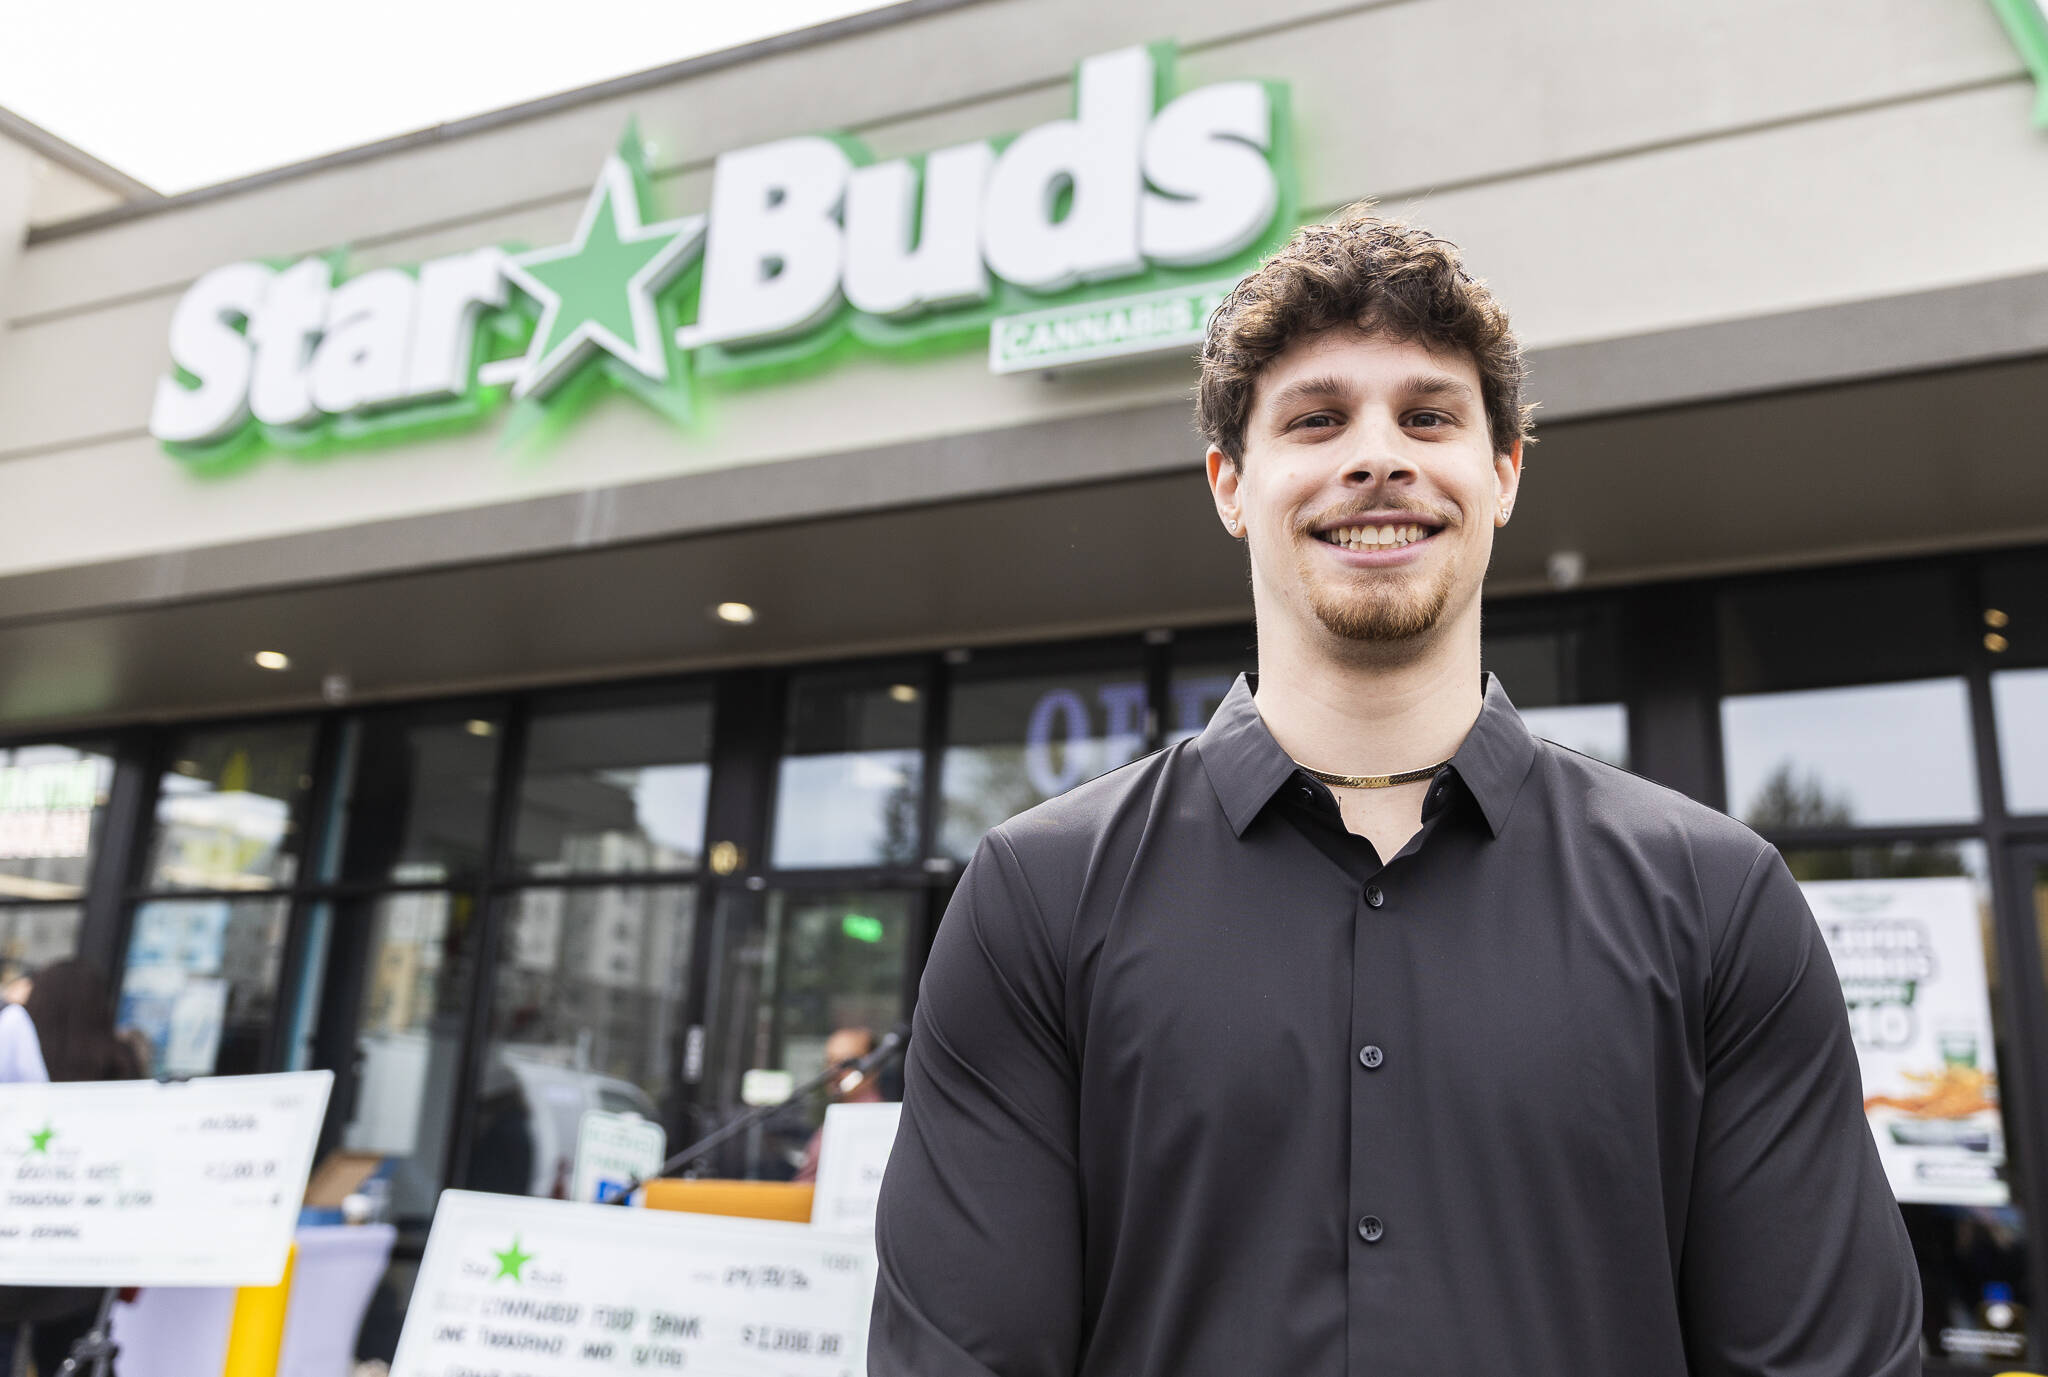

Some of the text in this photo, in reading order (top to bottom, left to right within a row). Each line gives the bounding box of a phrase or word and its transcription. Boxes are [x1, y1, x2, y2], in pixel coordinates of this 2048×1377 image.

[149, 44, 1278, 444] Star Buds
[1004, 296, 1191, 357] CANNABIS
